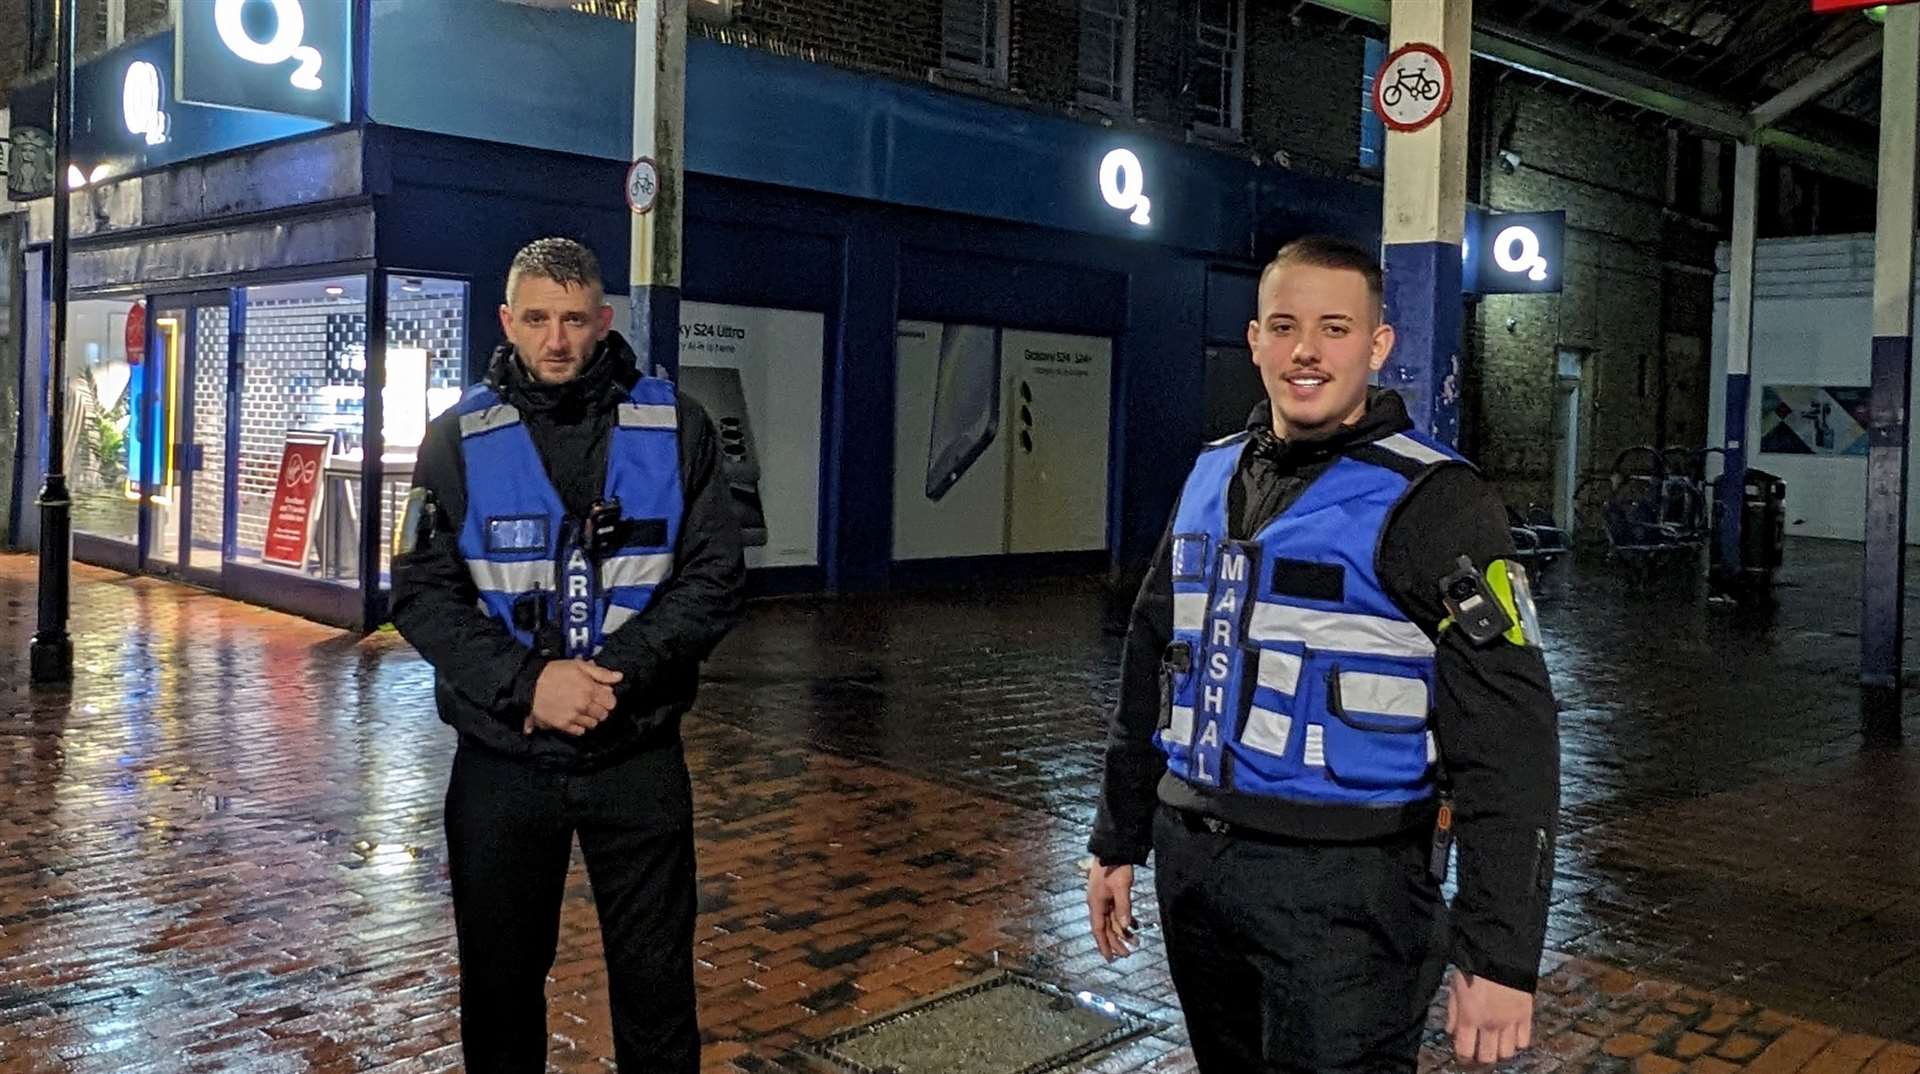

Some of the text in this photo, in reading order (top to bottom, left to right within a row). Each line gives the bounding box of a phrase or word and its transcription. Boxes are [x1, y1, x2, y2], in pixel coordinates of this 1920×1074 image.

[214, 0, 323, 92] O2
[1099, 148, 1150, 226] O2
[1493, 226, 1547, 281] O2
[694, 323, 714, 337] S24
[717, 324, 745, 339] Ultra
[567, 549, 589, 657] ARSH
[1198, 554, 1246, 782] MARSHAL
